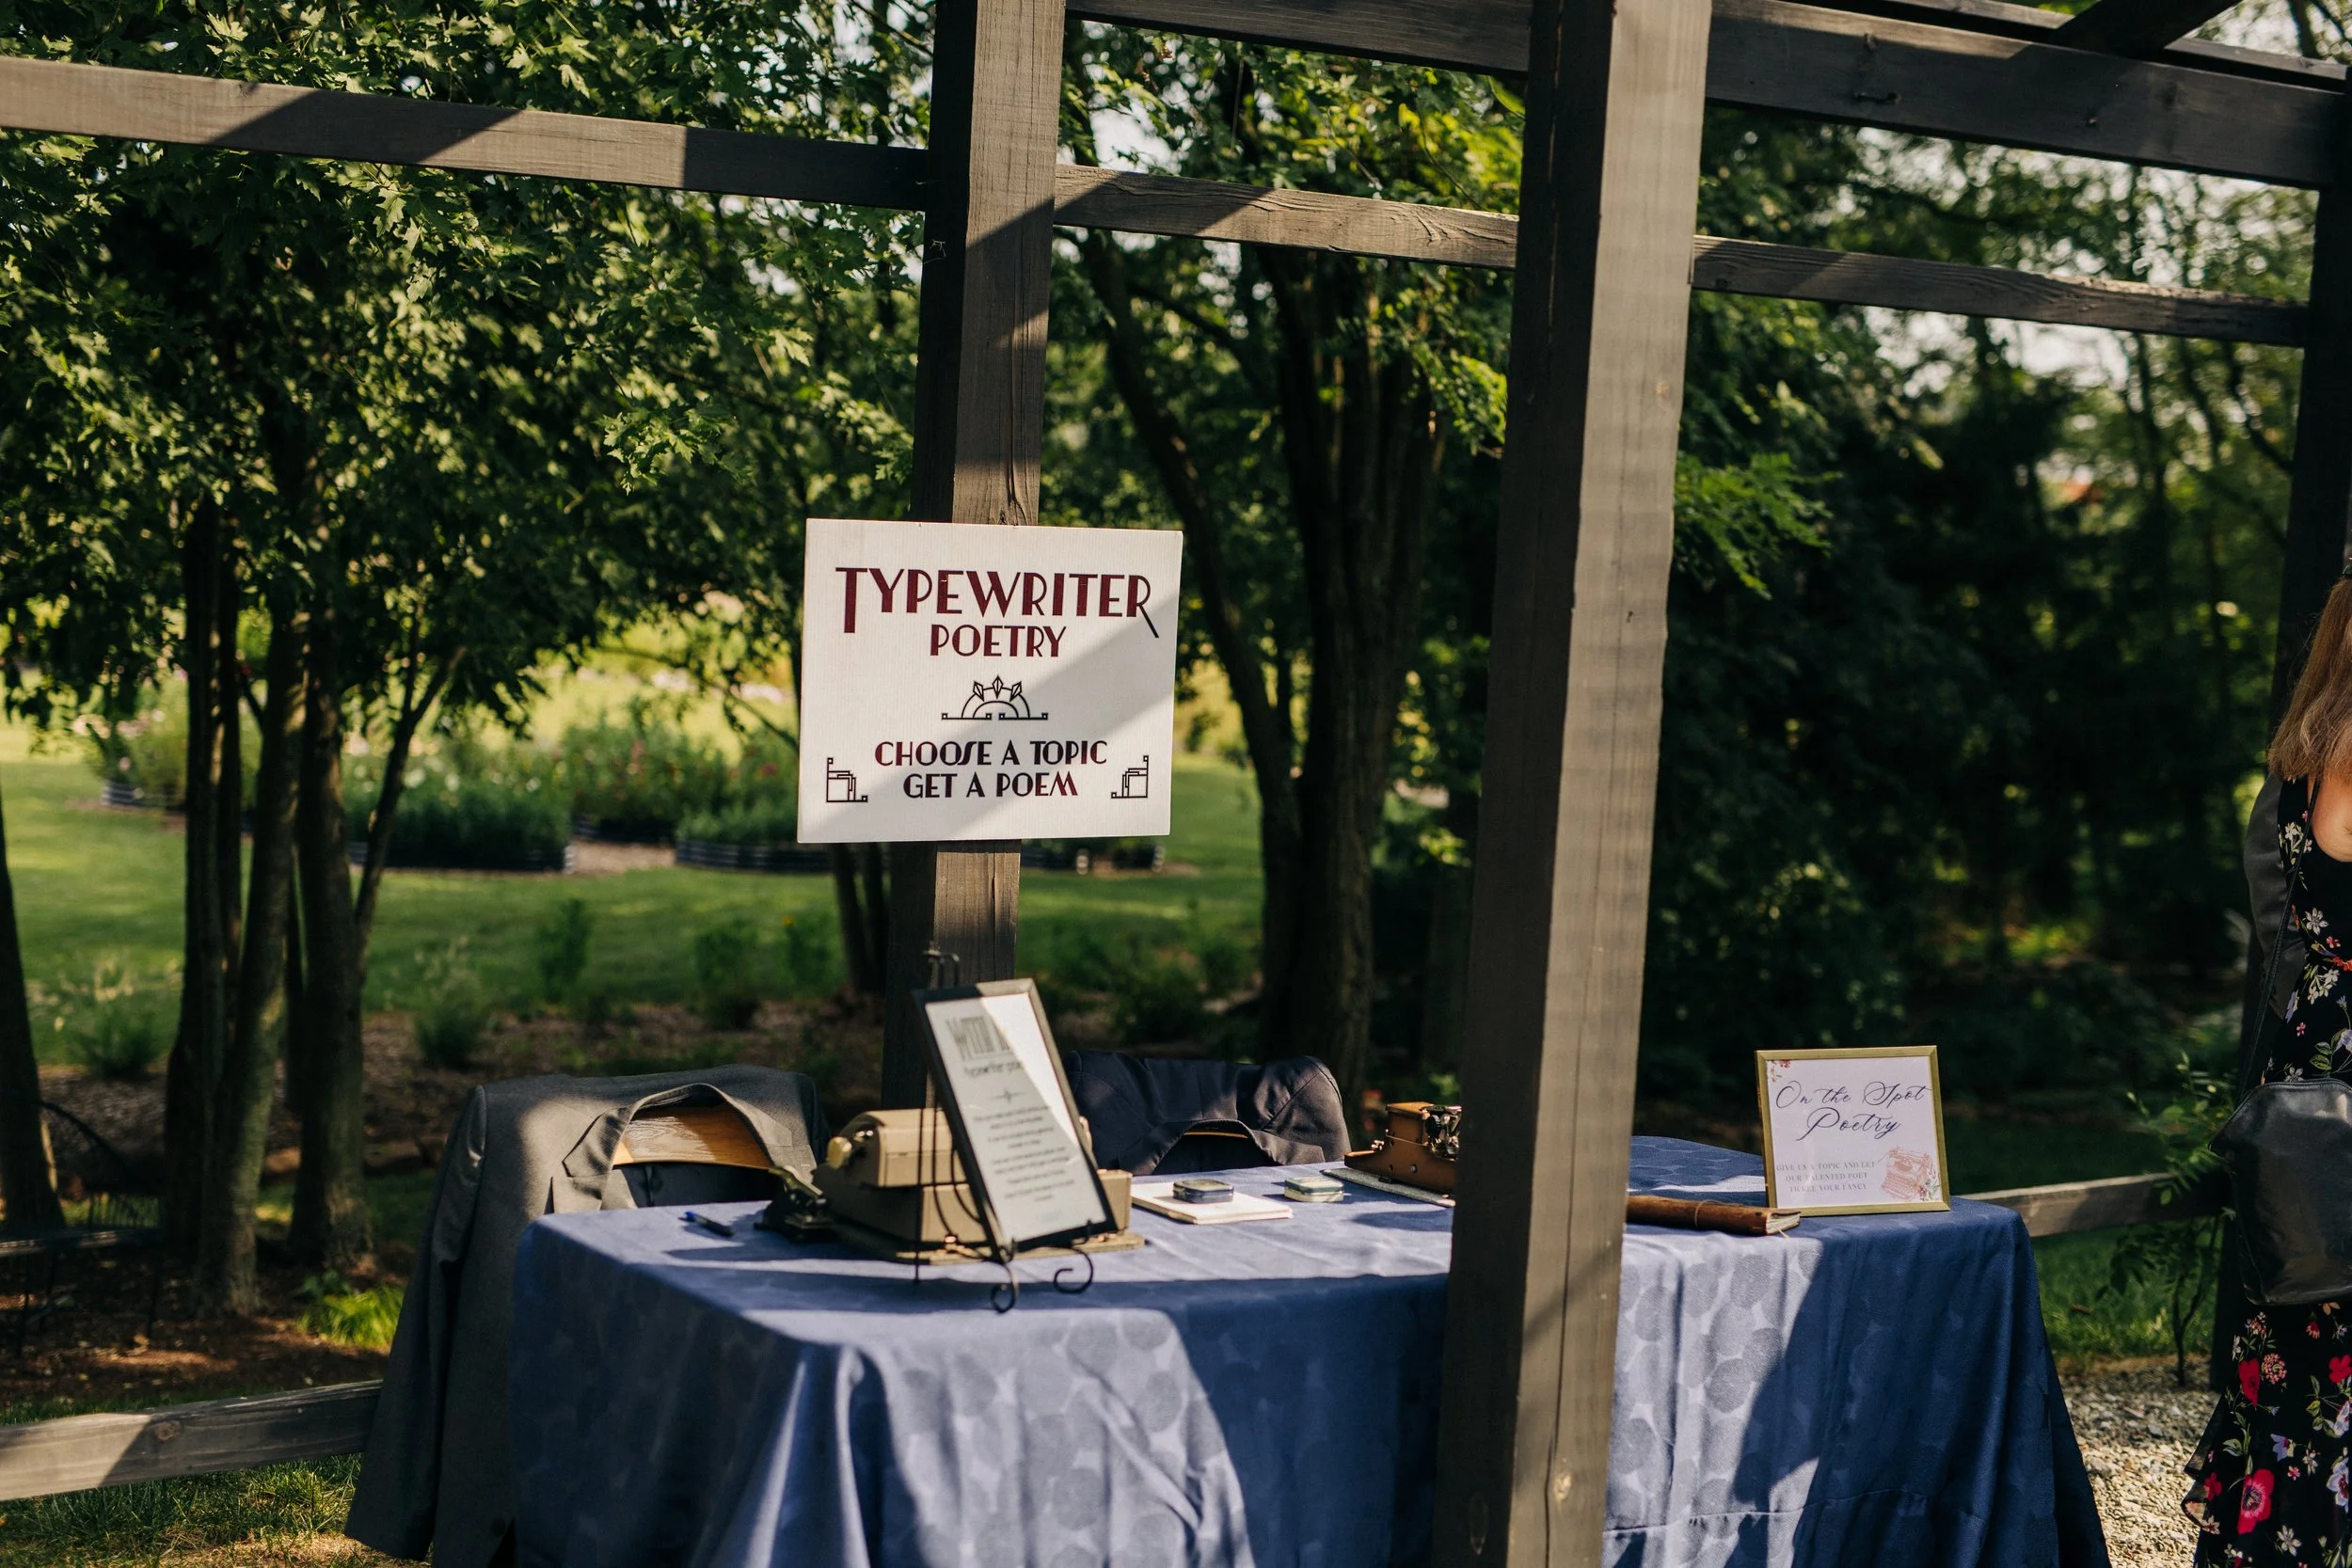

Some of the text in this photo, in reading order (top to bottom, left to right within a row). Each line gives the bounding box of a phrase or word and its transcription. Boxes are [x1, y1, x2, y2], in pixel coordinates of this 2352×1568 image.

[834, 566, 1160, 639] TYPEWRITER
[930, 624, 1067, 657] POETRY
[874, 739, 1108, 767] CHOOSE A TOPIC
[902, 771, 1079, 799] GET A POEM
[1775, 1080, 1931, 1109] On the Spot
[1796, 1106, 1902, 1142] Poetry
[1776, 1164, 1795, 1172] GIVE
[1818, 1162, 1841, 1170] TOPIC
[1843, 1161, 1859, 1169] AND
[1819, 1183, 1841, 1192] YOUR
[1842, 1182, 1867, 1191] FANCY
